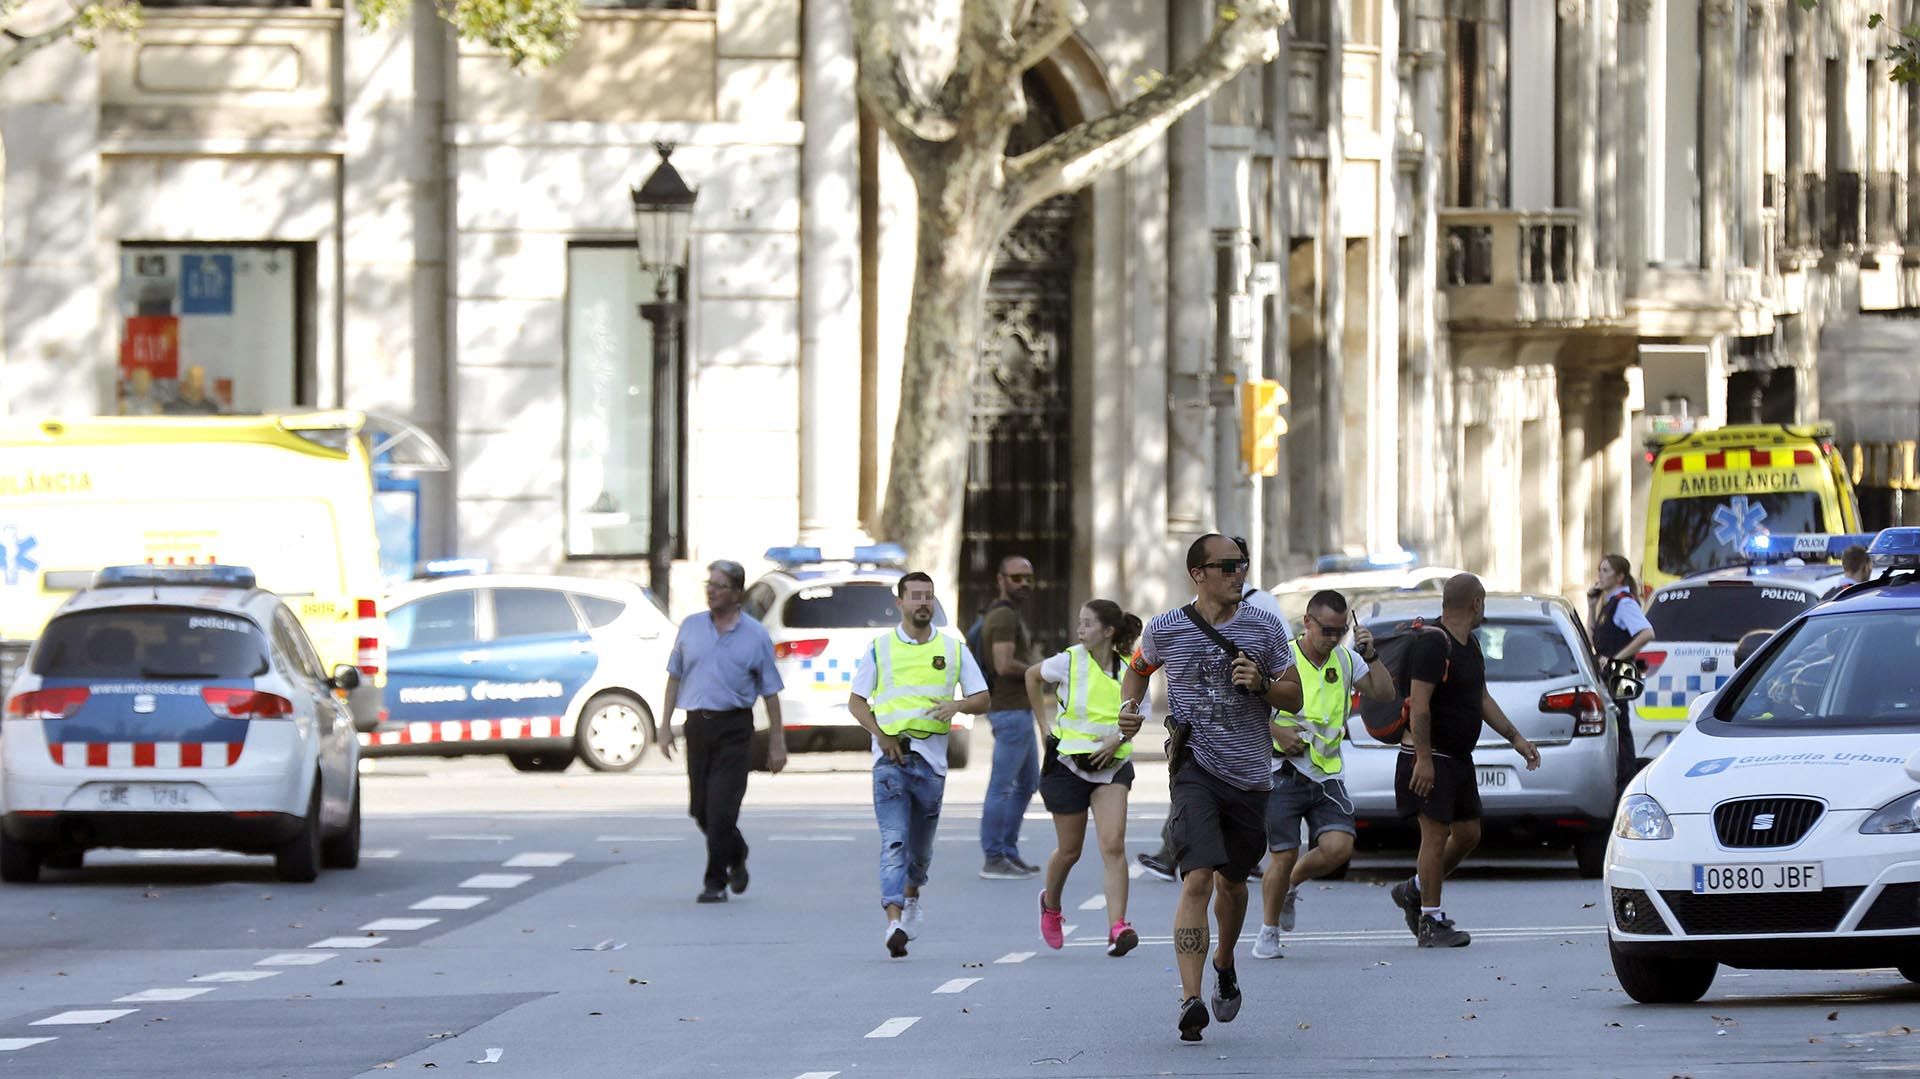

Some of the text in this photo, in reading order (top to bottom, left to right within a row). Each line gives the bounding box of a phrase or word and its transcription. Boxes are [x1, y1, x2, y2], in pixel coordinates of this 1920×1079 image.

[1680, 470, 1801, 495] AMBULÀNCIA
[1761, 588, 1806, 603] POLICIA
[89, 683, 202, 695] www.mossos.cat
[1707, 866, 1815, 889] 0880 JBF
